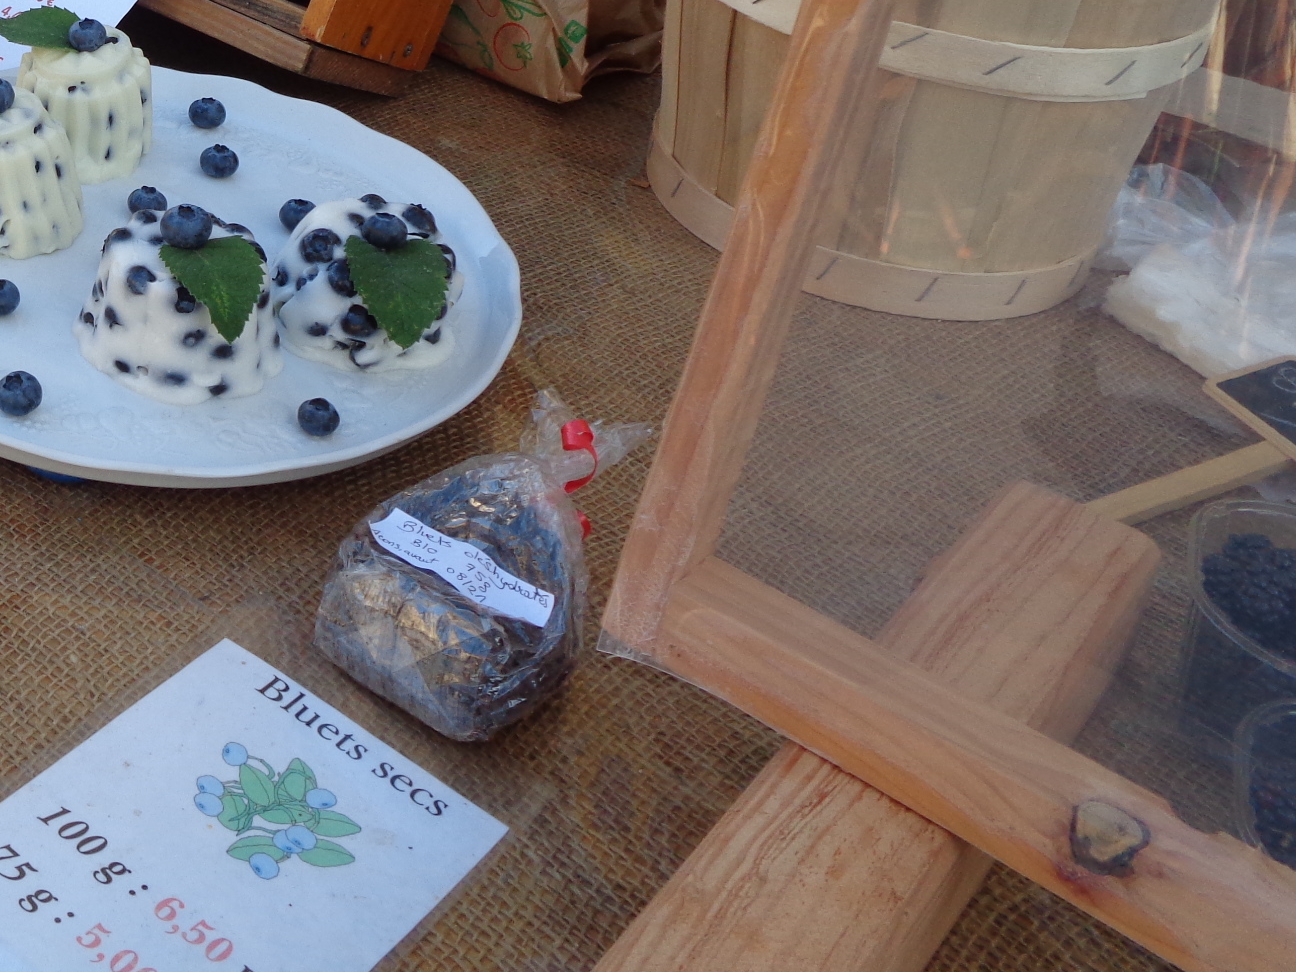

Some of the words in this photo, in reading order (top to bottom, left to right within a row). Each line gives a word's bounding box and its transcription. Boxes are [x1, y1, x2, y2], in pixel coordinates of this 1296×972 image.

[397, 520, 453, 549] Bluets
[446, 567, 487, 604] 08/21
[255, 675, 369, 761] Bluets
[371, 761, 449, 817] secs
[36, 806, 109, 856] 100
[154, 897, 234, 962] 6,50
[75, 922, 158, 972] 5,0
